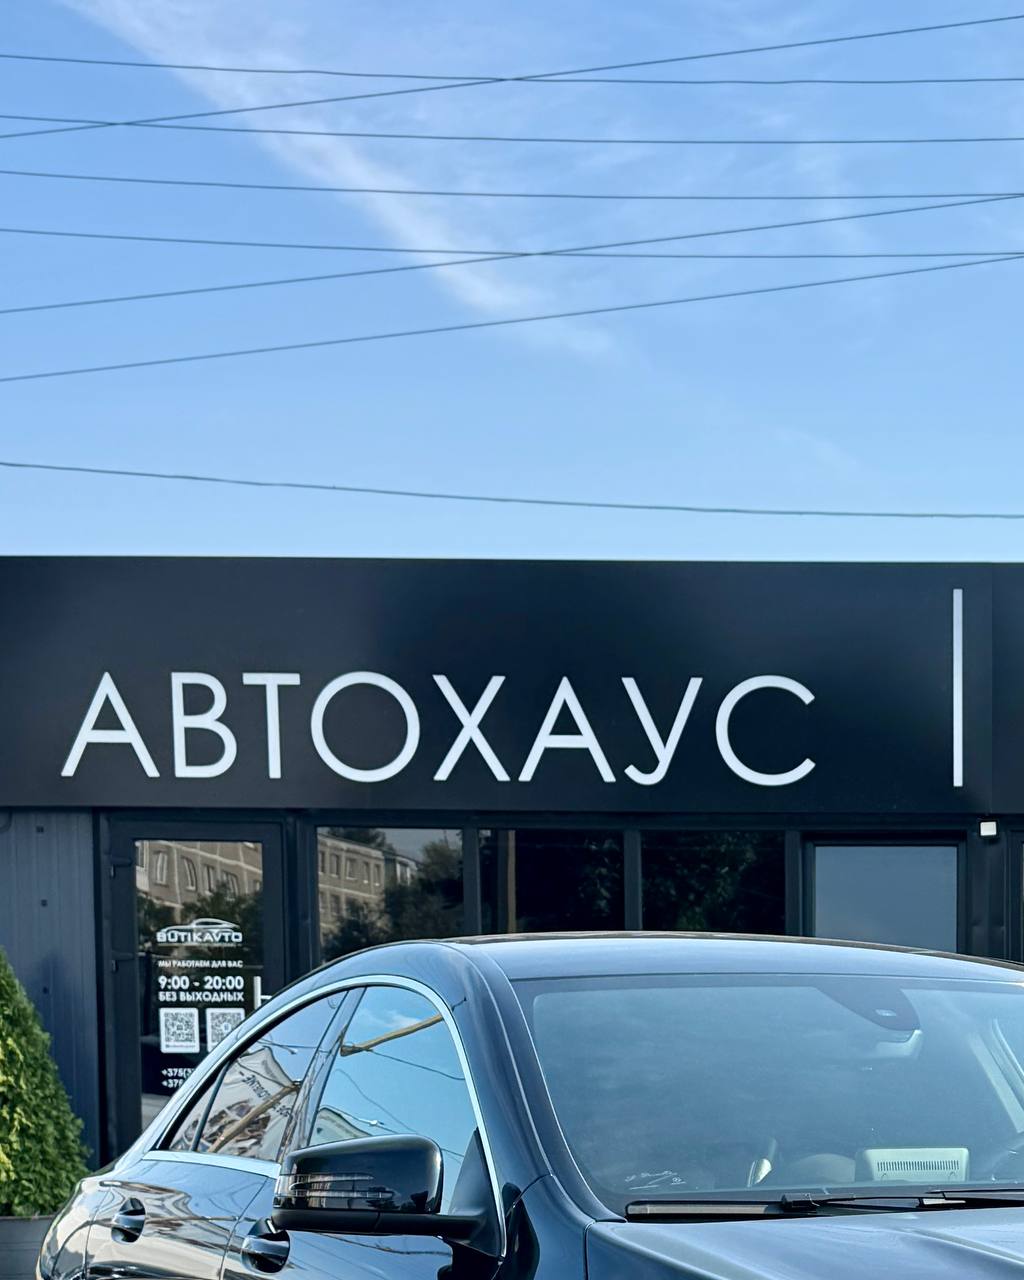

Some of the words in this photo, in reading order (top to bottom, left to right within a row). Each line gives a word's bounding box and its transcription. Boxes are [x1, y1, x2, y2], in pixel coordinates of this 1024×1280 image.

[62, 671, 817, 787] АВТОХАУС
[156, 931, 243, 942] BUTIKAVTO
[172, 960, 210, 968] РАБОТАЕМ
[211, 960, 227, 968] ДЛЯ
[228, 960, 243, 968] ВАС
[158, 976, 190, 990] 9:00
[204, 976, 244, 990] 20:00
[158, 991, 177, 1002] БЕЗ
[180, 991, 244, 1002] ВЫХОДНЫХ
